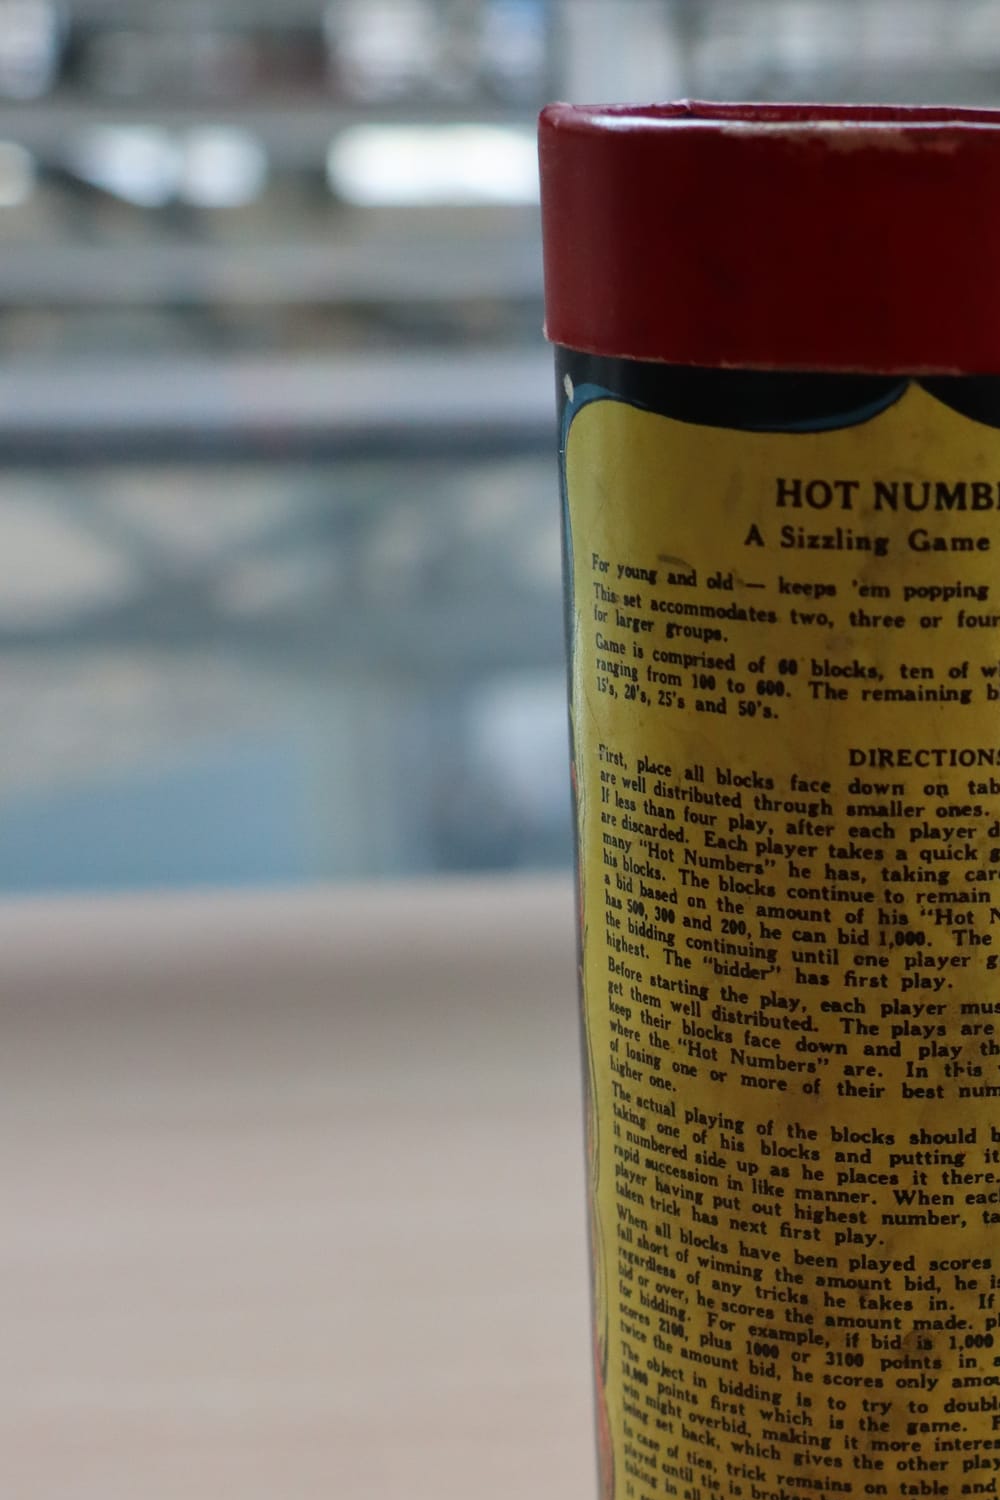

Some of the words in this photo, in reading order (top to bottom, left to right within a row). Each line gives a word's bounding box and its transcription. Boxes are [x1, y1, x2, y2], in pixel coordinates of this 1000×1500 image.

[776, 478, 860, 510] HOT
[744, 524, 764, 547] A
[781, 525, 889, 554] Sizzling
[908, 528, 990, 552] Game
[591, 553, 610, 573] For
[617, 564, 657, 585] young
[667, 569, 697, 587] and
[707, 572, 733, 591] old
[779, 576, 837, 599] keeps
[853, 580, 890, 598] 'em
[904, 581, 989, 602] popping
[593, 582, 619, 604] This
[623, 594, 642, 609] set
[650, 599, 777, 623] accommodates
[791, 610, 834, 628] two,
[850, 609, 905, 628] three
[920, 617, 942, 628] or
[593, 604, 608, 623] for
[615, 609, 654, 633] larger
[665, 622, 728, 644] groups.
[595, 632, 626, 655] Game
[633, 641, 644, 659] is
[652, 650, 735, 671] comprised
[748, 656, 765, 673] of
[778, 659, 797, 675] 60
[812, 659, 884, 681] blocks,
[900, 664, 934, 679] ten
[948, 661, 969, 679] of
[596, 658, 638, 682] ranging
[647, 665, 682, 686] from
[692, 674, 716, 690] 100
[727, 678, 745, 693] to
[757, 680, 790, 697] 600.
[808, 681, 848, 700] The
[862, 684, 972, 704] remaining
[624, 683, 651, 707] 20's,
[658, 690, 685, 709] 25's
[695, 697, 727, 715] and
[738, 700, 778, 719] 50's.
[637, 755, 671, 777] place
[684, 765, 704, 783] all
[716, 768, 773, 790] blocks
[791, 774, 831, 793] face
[848, 778, 904, 795] down
[924, 784, 949, 798] on
[605, 888, 623, 910] has
[654, 906, 675, 924] 300
[682, 915, 712, 932] and
[721, 918, 752, 939] 200,
[760, 921, 782, 940] he
[792, 931, 826, 943] can
[838, 928, 869, 946] bid
[952, 929, 992, 946] The
[606, 932, 649, 959] highest.
[662, 948, 692, 969] The
[795, 967, 830, 986] has
[844, 970, 888, 988] first
[901, 972, 952, 991] play.
[609, 1055, 643, 1082] higher
[649, 1075, 676, 1092] one.
[649, 1195, 681, 1217] trick
[691, 1204, 718, 1226] has
[729, 1218, 767, 1235] next
[780, 1221, 821, 1241] first
[835, 1227, 884, 1247] play.
[653, 1334, 673, 1354] the
[680, 1348, 738, 1372] amount
[749, 1359, 781, 1381] bid,
[792, 1365, 813, 1383] he
[823, 1374, 884, 1388] scores
[896, 1373, 939, 1391] only
